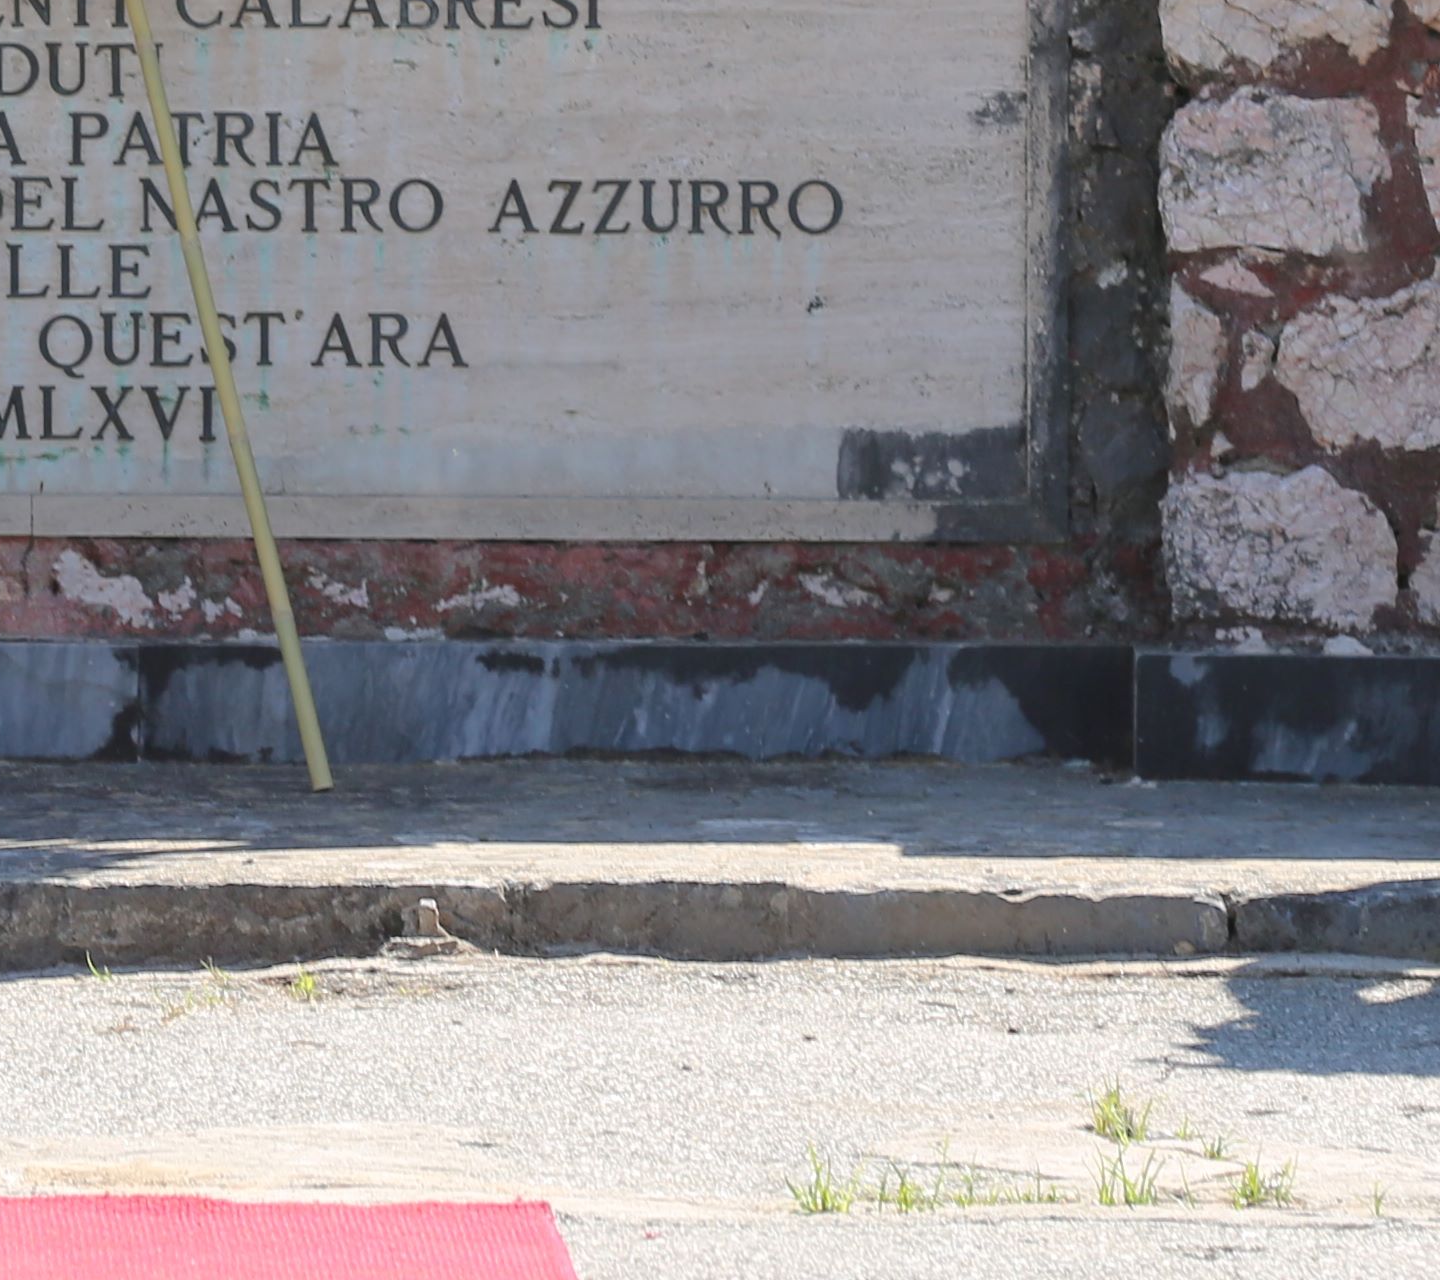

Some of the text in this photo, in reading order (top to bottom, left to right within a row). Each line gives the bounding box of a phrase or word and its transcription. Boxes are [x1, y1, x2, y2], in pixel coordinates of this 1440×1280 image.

[67, 110, 340, 168] PATRIA
[138, 176, 444, 234] NASTRO
[487, 178, 844, 240] AZZURRO
